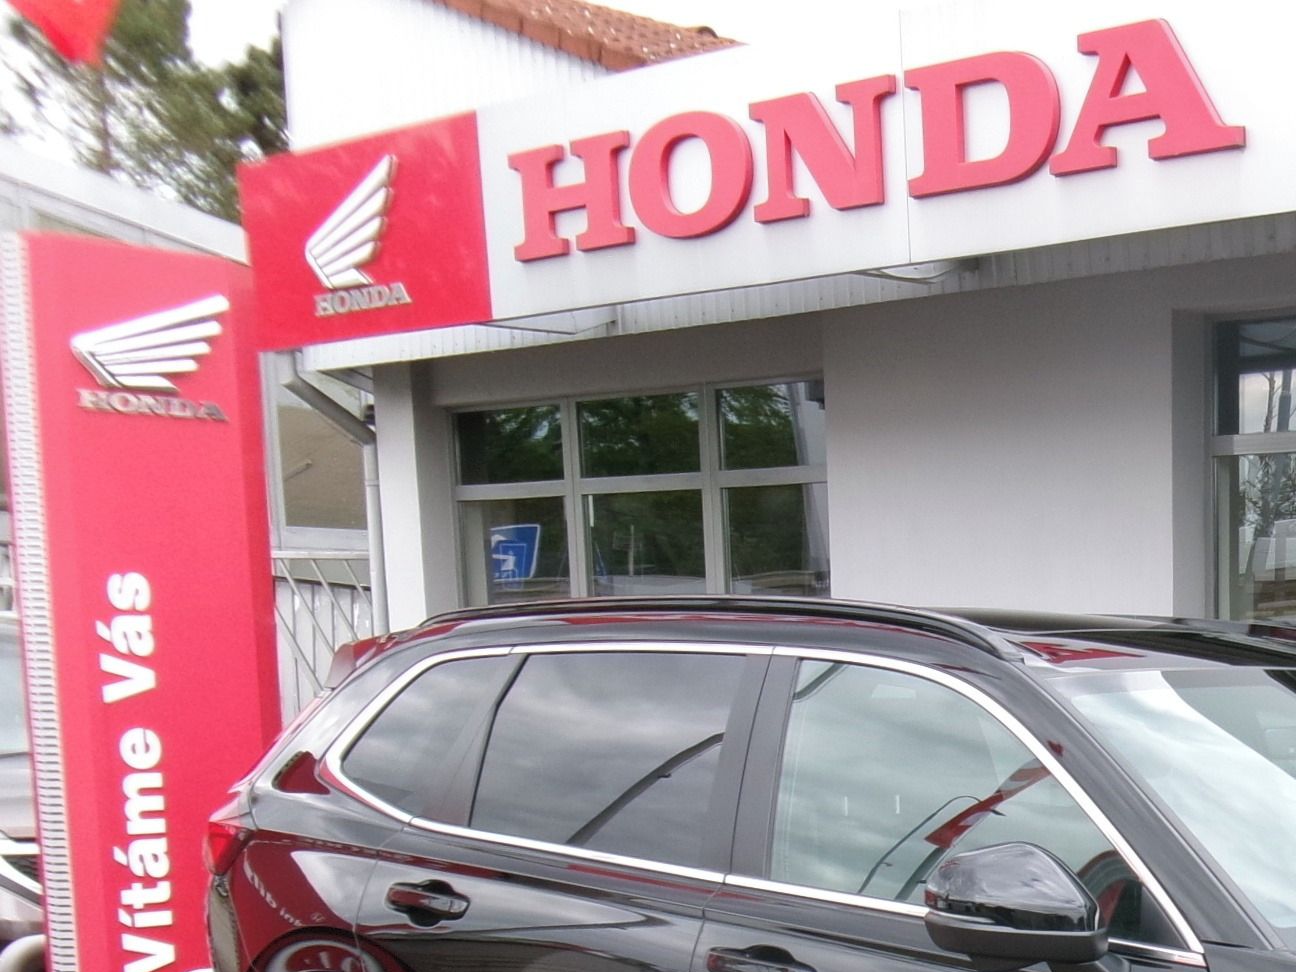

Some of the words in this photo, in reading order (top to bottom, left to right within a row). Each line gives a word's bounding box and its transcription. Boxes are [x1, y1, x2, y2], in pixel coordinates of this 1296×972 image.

[508, 18, 1246, 263] HONDA
[314, 282, 411, 318] HONDA
[77, 387, 228, 422] HONDA
[95, 571, 158, 703] Vás
